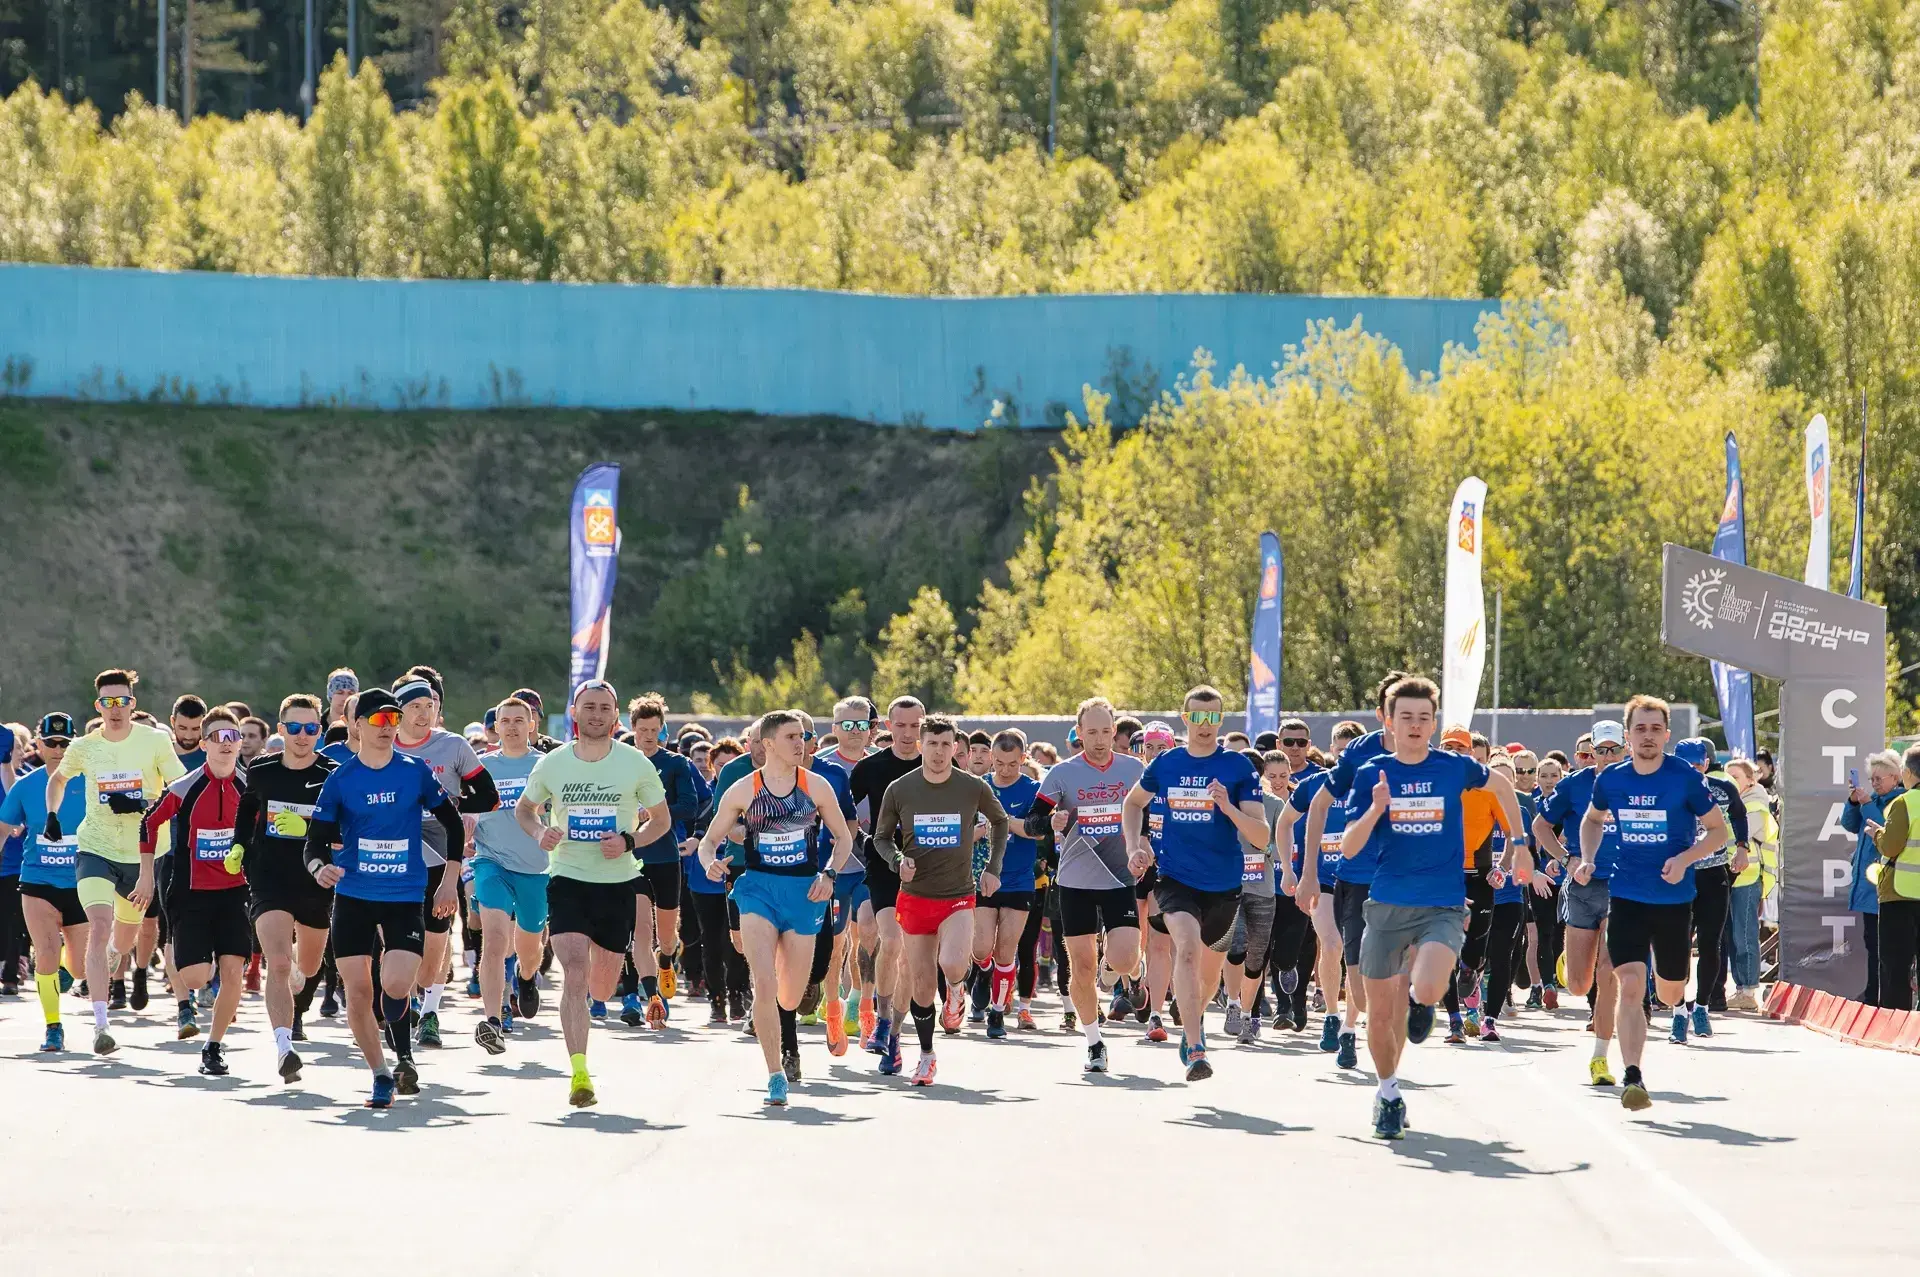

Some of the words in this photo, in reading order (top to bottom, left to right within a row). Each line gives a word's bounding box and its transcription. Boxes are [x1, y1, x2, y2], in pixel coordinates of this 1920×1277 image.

[1723, 584, 1736, 597] НА
[1720, 595, 1752, 613] СЕВЕРЕ
[562, 783, 594, 793] NIKE
[562, 793, 622, 803] RUNNING
[1172, 811, 1212, 821] 00109
[1081, 825, 1119, 835] 10085
[1391, 823, 1443, 833] 00009
[918, 836, 957, 845] 50105
[1622, 832, 1667, 842] 50030
[199, 849, 231, 859] 5010
[763, 852, 805, 864] 50106
[41, 855, 74, 864] 50011
[358, 863, 407, 873] 50078
